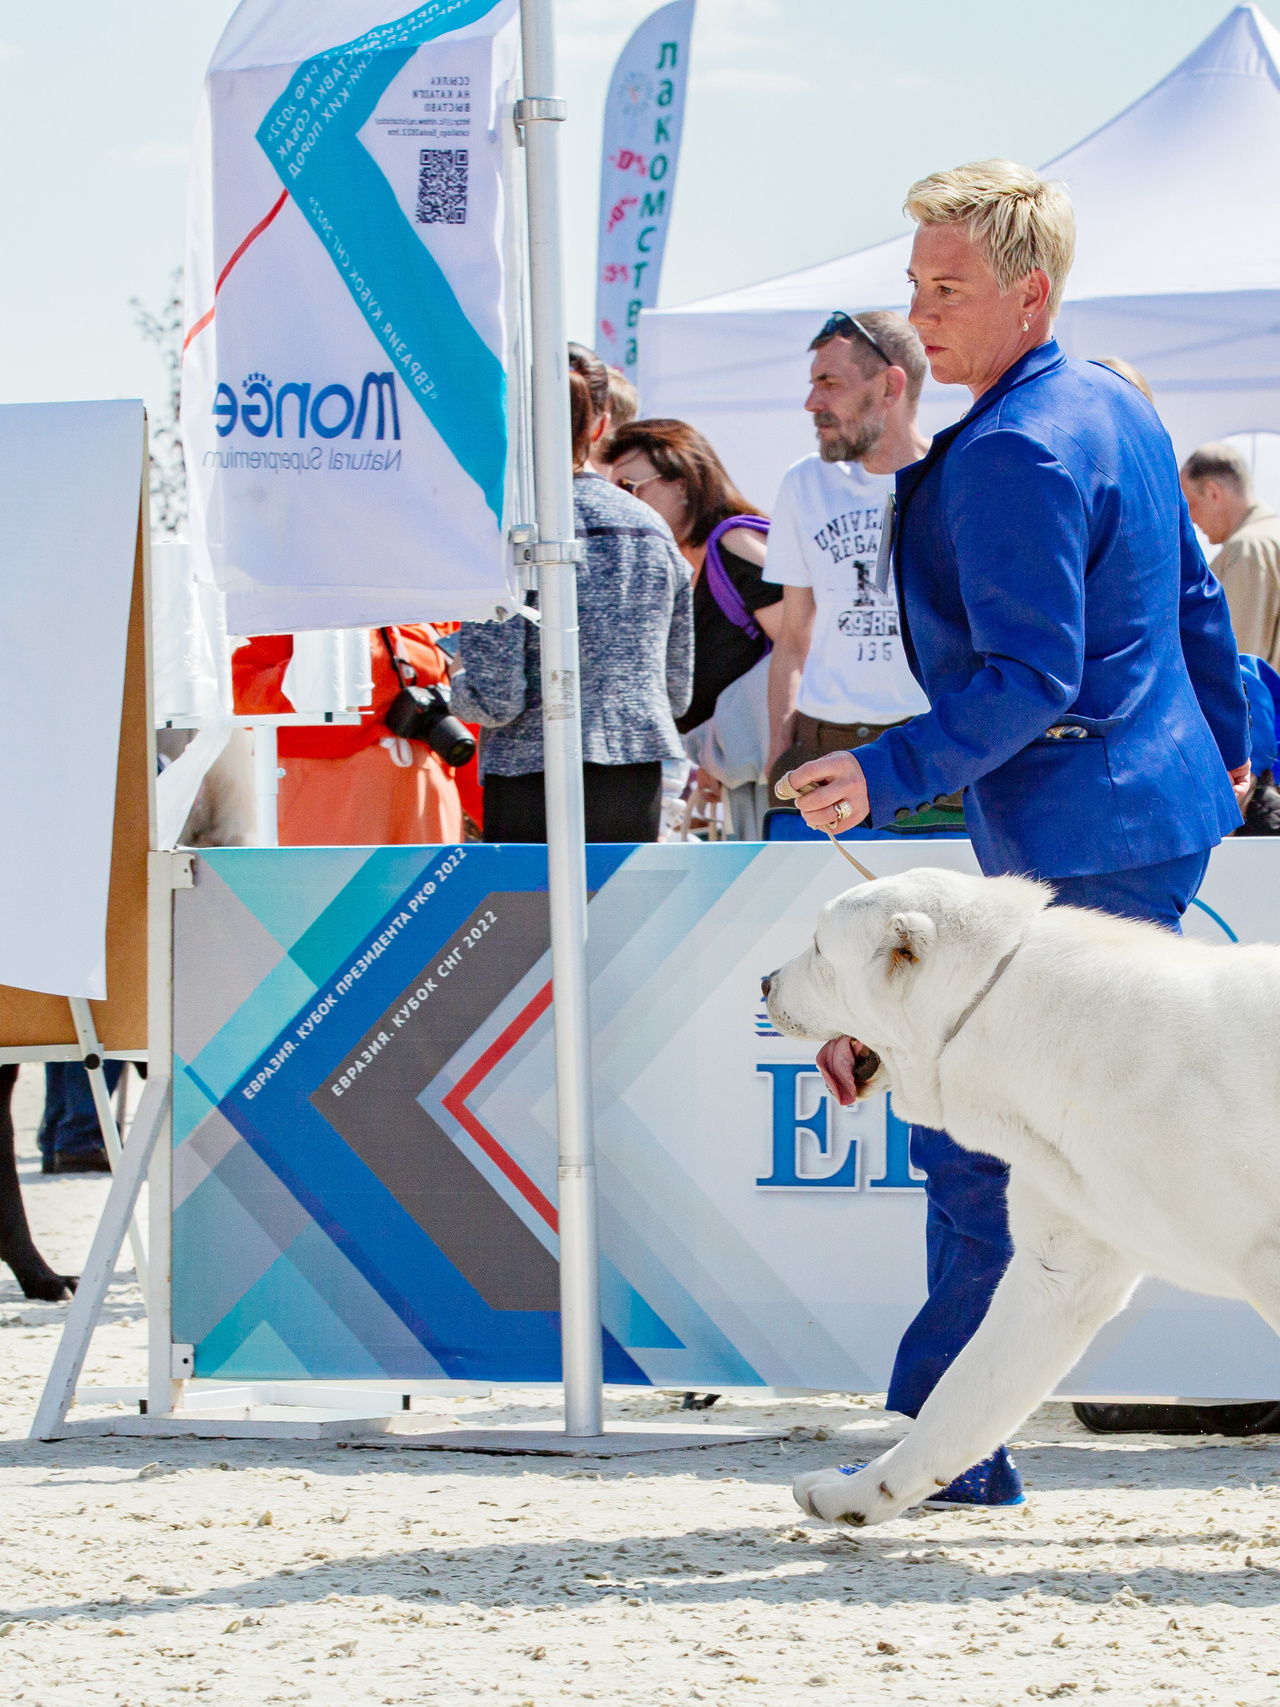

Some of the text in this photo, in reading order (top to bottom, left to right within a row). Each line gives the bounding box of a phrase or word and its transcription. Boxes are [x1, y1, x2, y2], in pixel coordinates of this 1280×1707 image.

[814, 508, 884, 551] UNIVE
[242, 847, 467, 1100] ЕВРАЗИЯ. КУБОК ПРЕЗИДЕНТА РКФ 2022
[331, 910, 498, 1097] ЕВРАЗИЯ. КУБОК СНГ 2022
